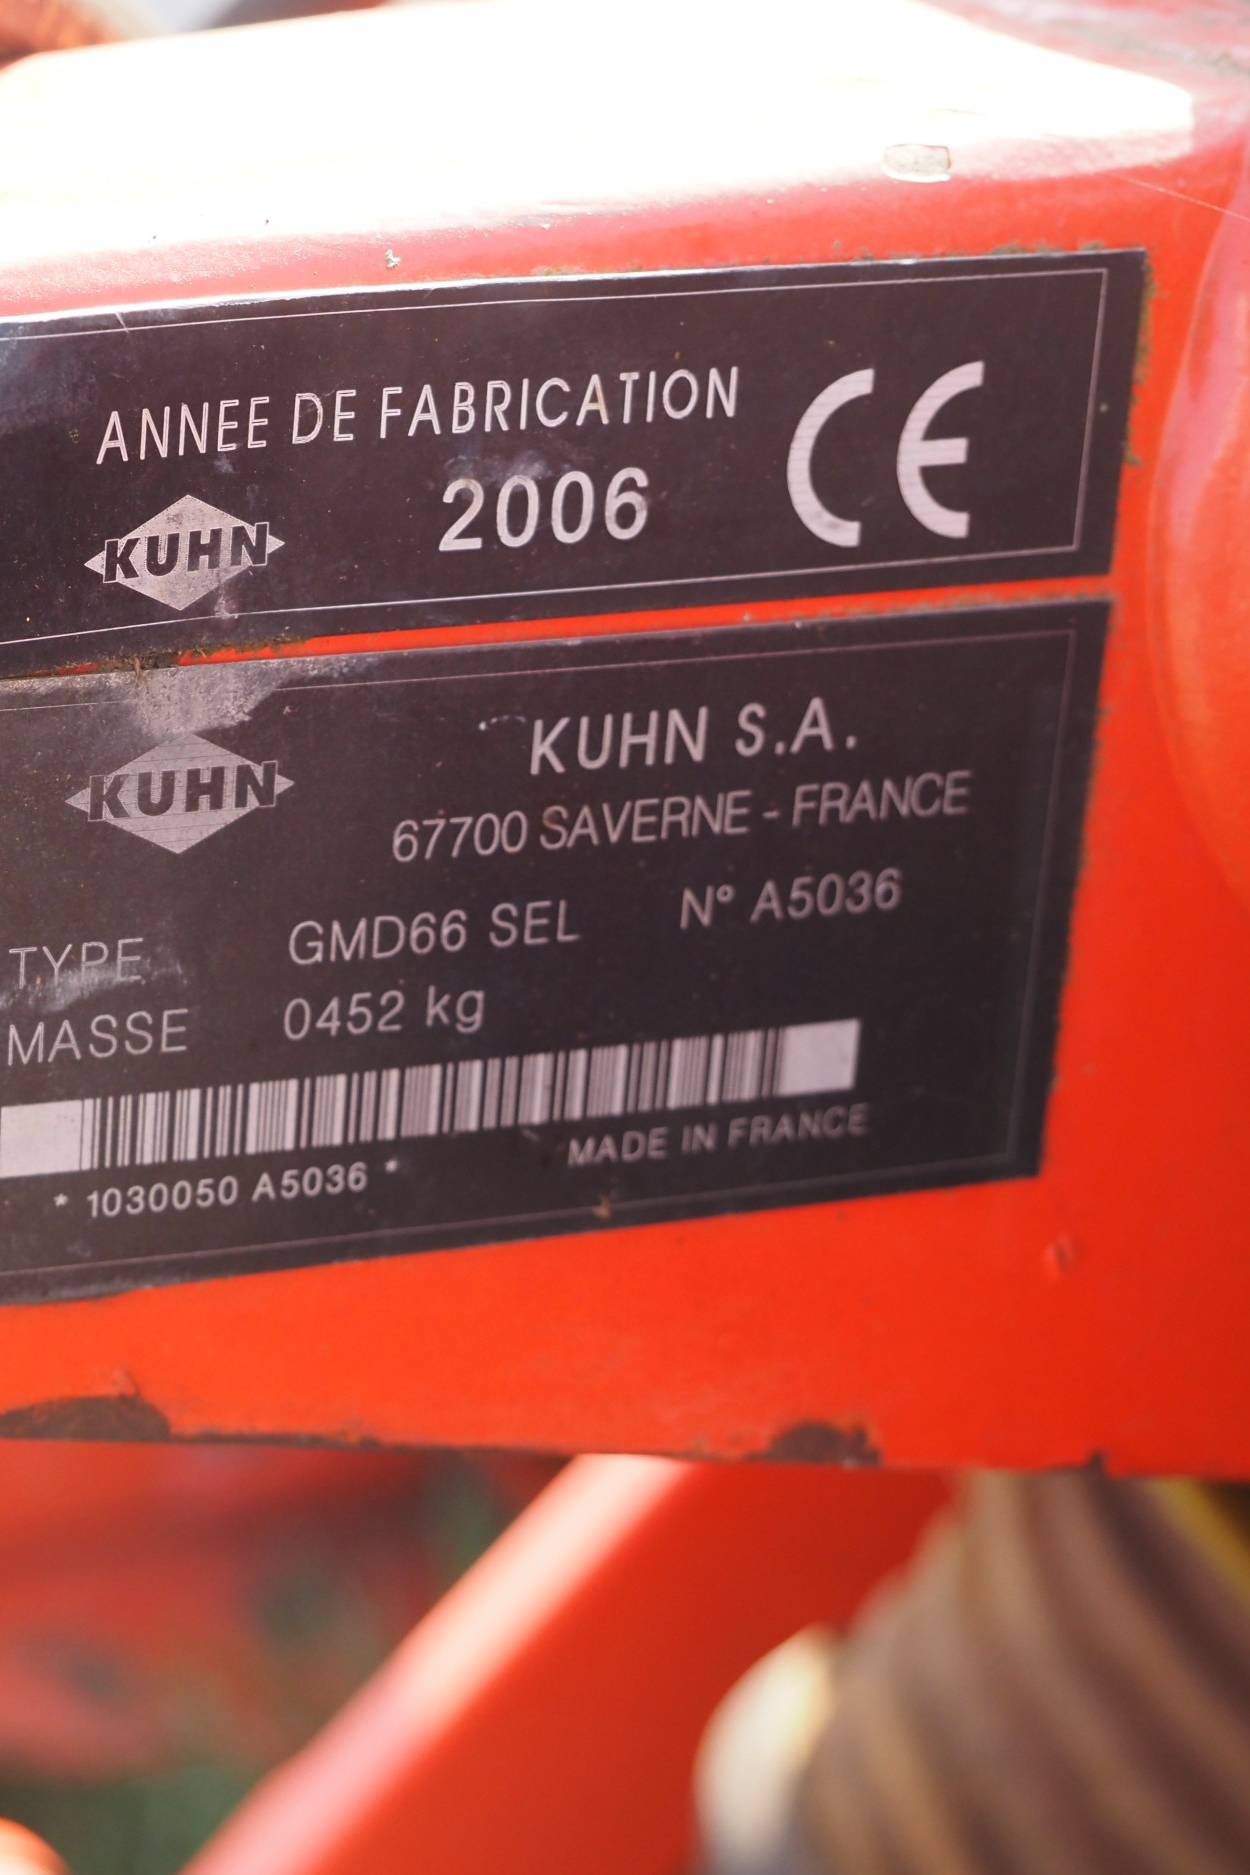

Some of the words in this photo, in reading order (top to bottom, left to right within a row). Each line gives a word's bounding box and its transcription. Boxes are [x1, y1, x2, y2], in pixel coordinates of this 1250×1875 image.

[96, 396, 270, 465] ANNEE
[292, 390, 356, 445] DE
[378, 366, 739, 439] FABRICATION
[787, 361, 985, 548] CE
[439, 467, 650, 552] 2006
[102, 521, 269, 583] KUHN
[530, 706, 708, 775] KUHN
[735, 697, 857, 758] S.A.
[88, 760, 278, 822] KUHN
[392, 810, 529, 863] 67700
[539, 790, 752, 851] SAVERNE
[792, 770, 972, 826] FRANCE
[750, 868, 904, 922] A5036
[8, 937, 144, 990] TYPE
[288, 909, 468, 966] GMD66
[488, 900, 581, 948] SEL
[6, 1008, 190, 1067] MASSE
[283, 988, 405, 1041] 0452
[426, 985, 486, 1034] kg
[568, 1126, 669, 1169] MADE
[681, 1121, 717, 1154] IN
[728, 1102, 869, 1149] FRANCE
[86, 1175, 239, 1219] 1030050
[252, 1161, 369, 1201] A5036
